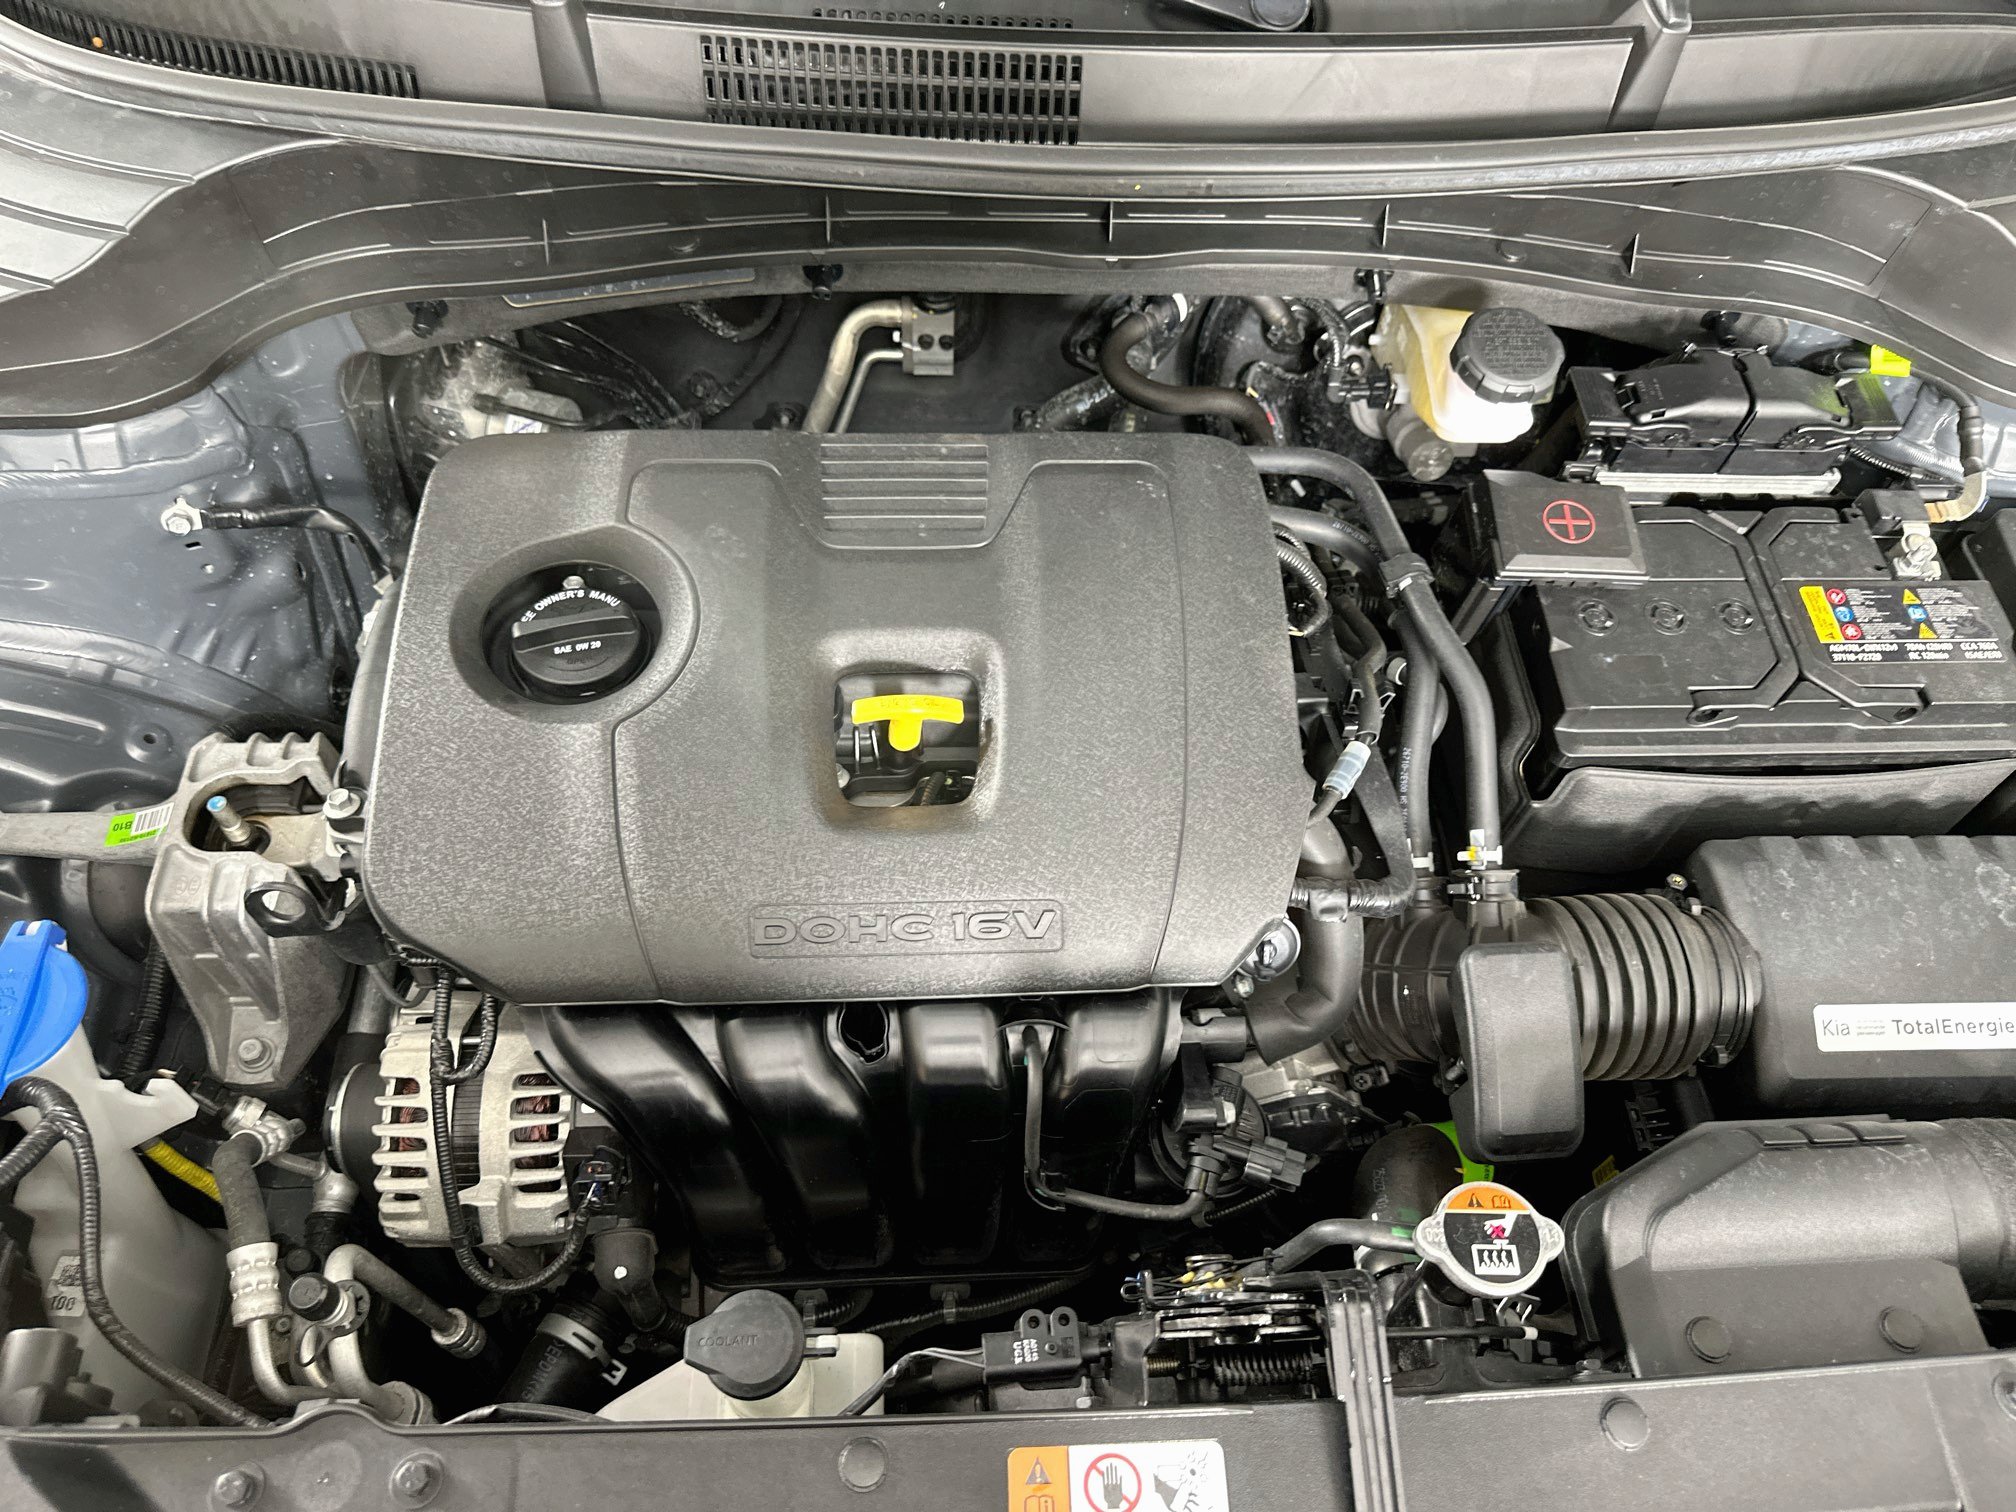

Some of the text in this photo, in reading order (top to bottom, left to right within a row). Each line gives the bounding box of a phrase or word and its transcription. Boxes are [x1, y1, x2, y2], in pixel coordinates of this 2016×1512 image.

[534, 589, 585, 611] OWNER'S
[589, 590, 621, 607] MANU
[554, 640, 601, 655] SAE 0W 20
[113, 821, 133, 832] B10
[754, 909, 1056, 945] DOHC 16V
[1822, 1019, 1851, 1036] Kia
[1891, 1017, 2015, 1037] TotalEnergie
[698, 1334, 758, 1347] COOLANT
